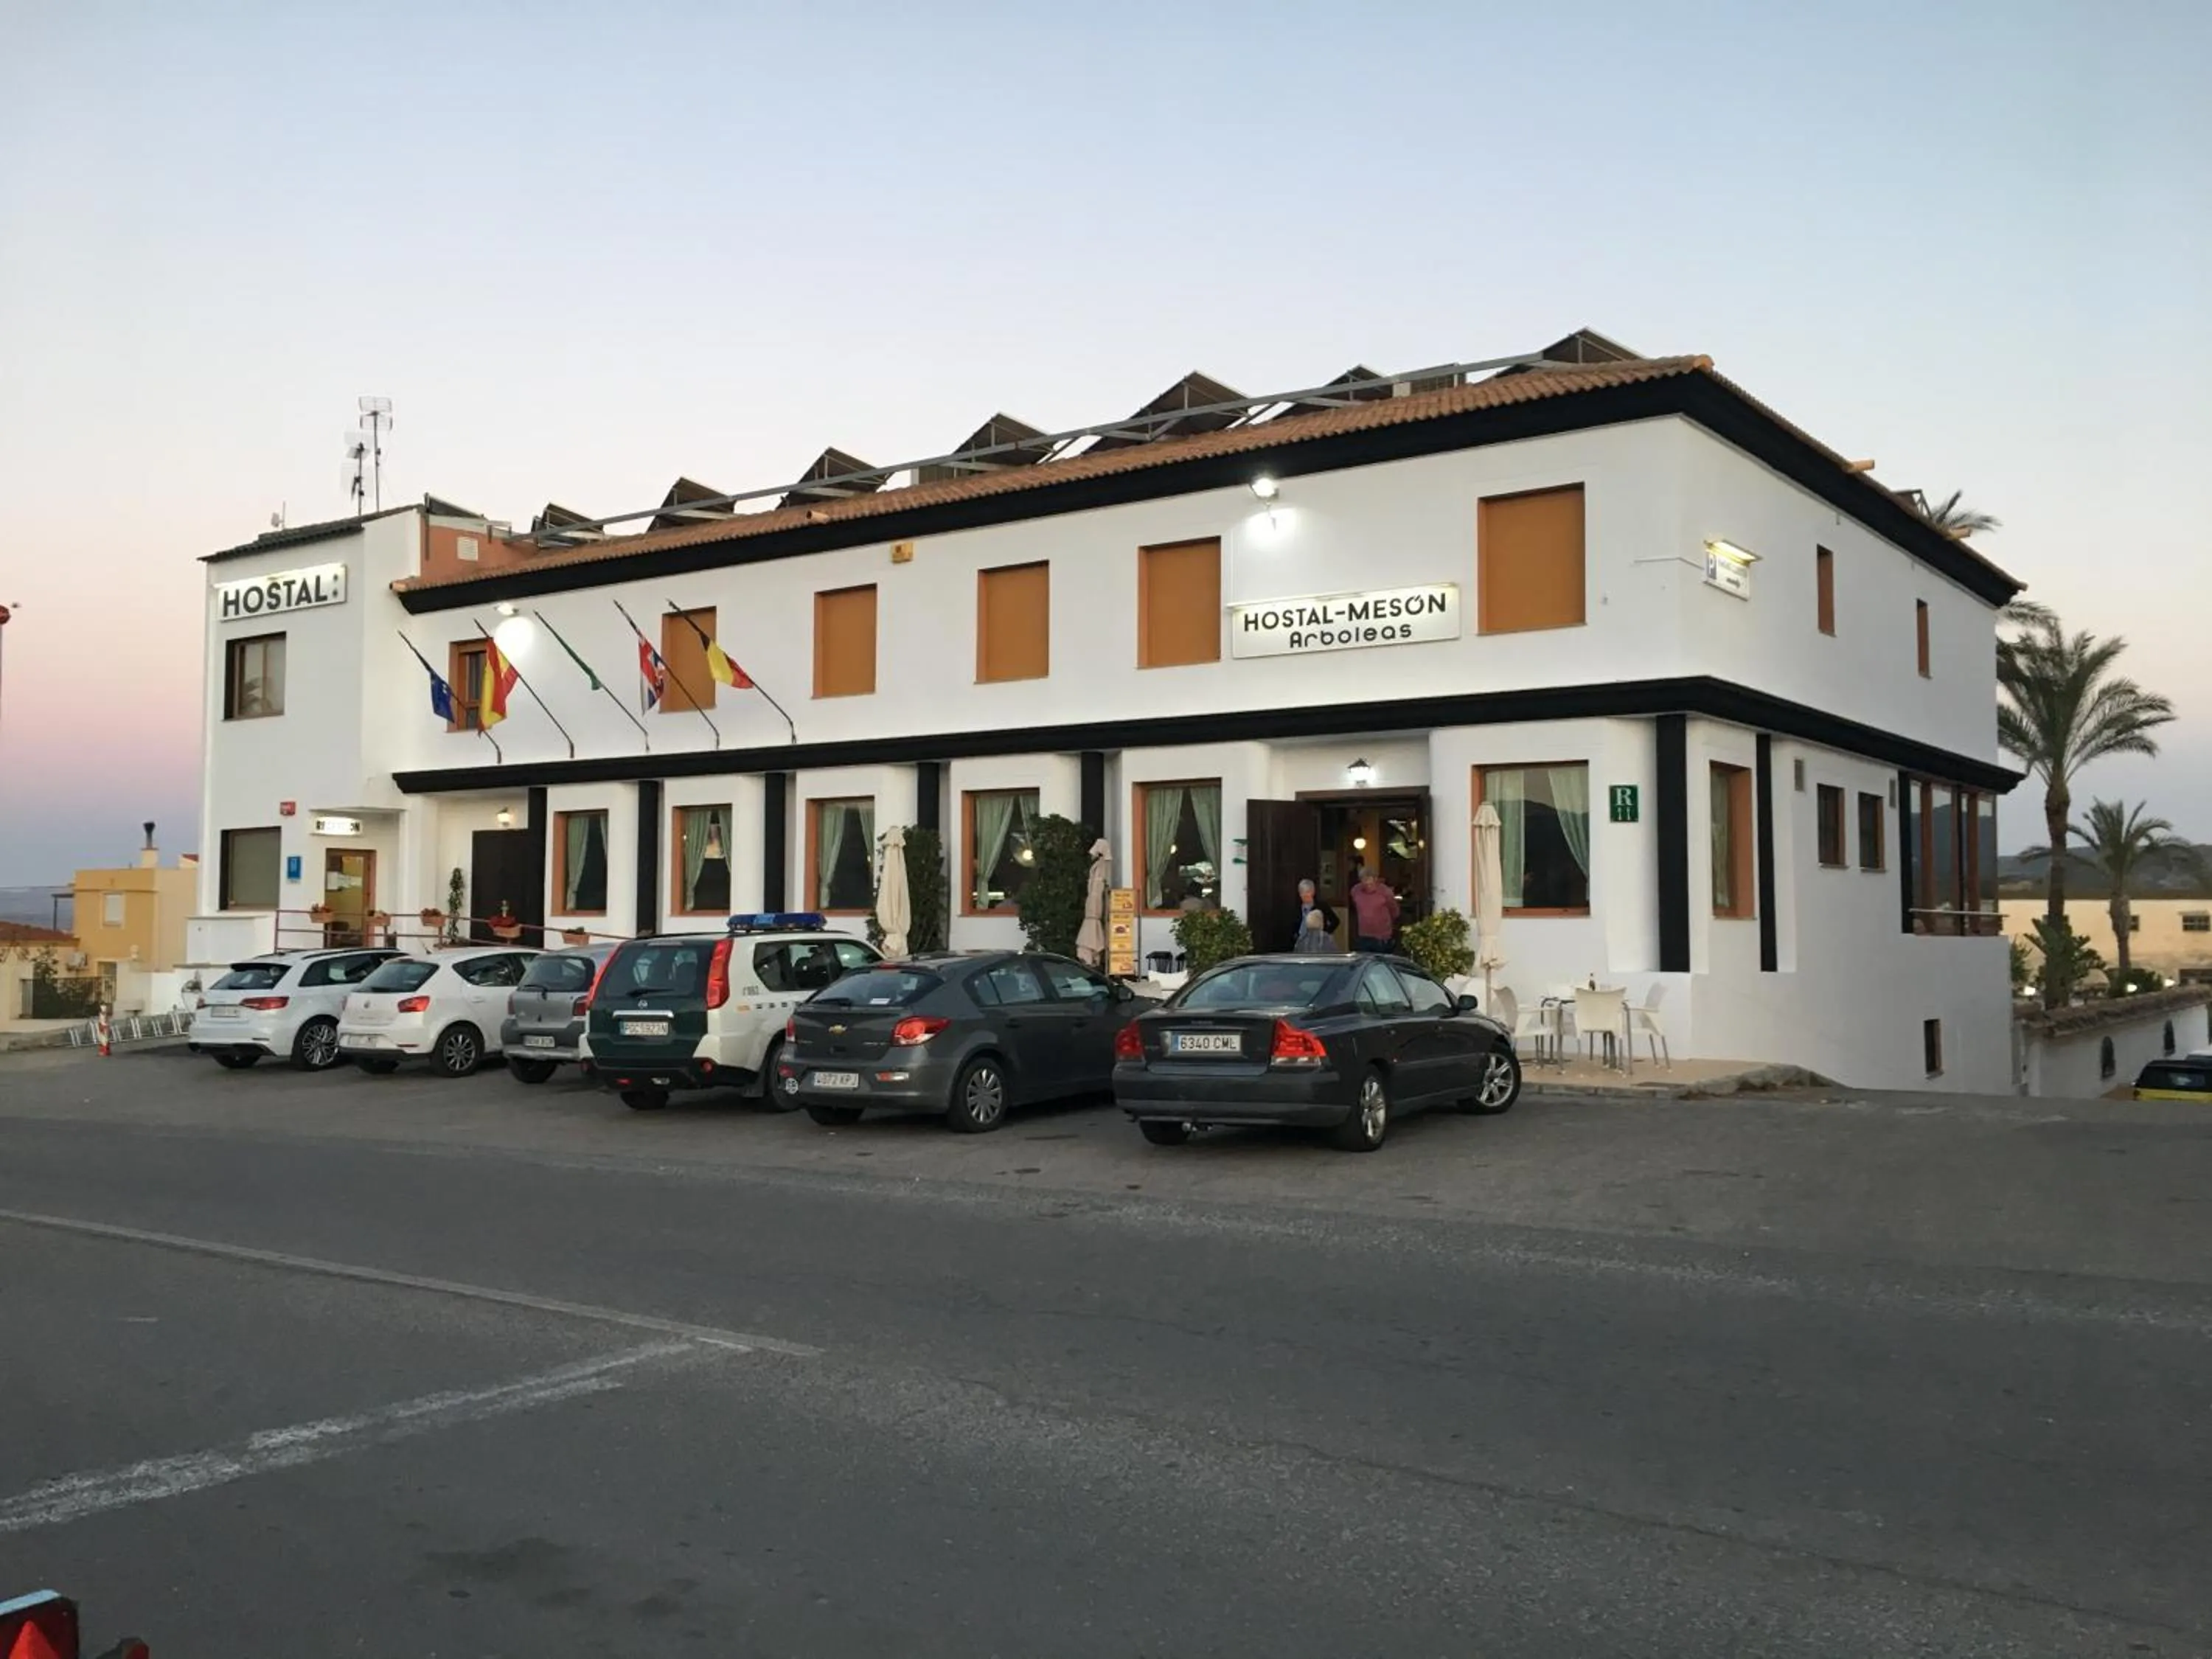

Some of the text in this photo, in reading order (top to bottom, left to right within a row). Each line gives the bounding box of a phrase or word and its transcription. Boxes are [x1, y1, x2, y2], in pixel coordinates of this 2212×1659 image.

[1244, 593, 1446, 632] HOSTAL-MESÓN
[1290, 624, 1412, 649] Arboleas
[1615, 787, 1633, 806] R
[1180, 1037, 1237, 1050] 6340 CML
